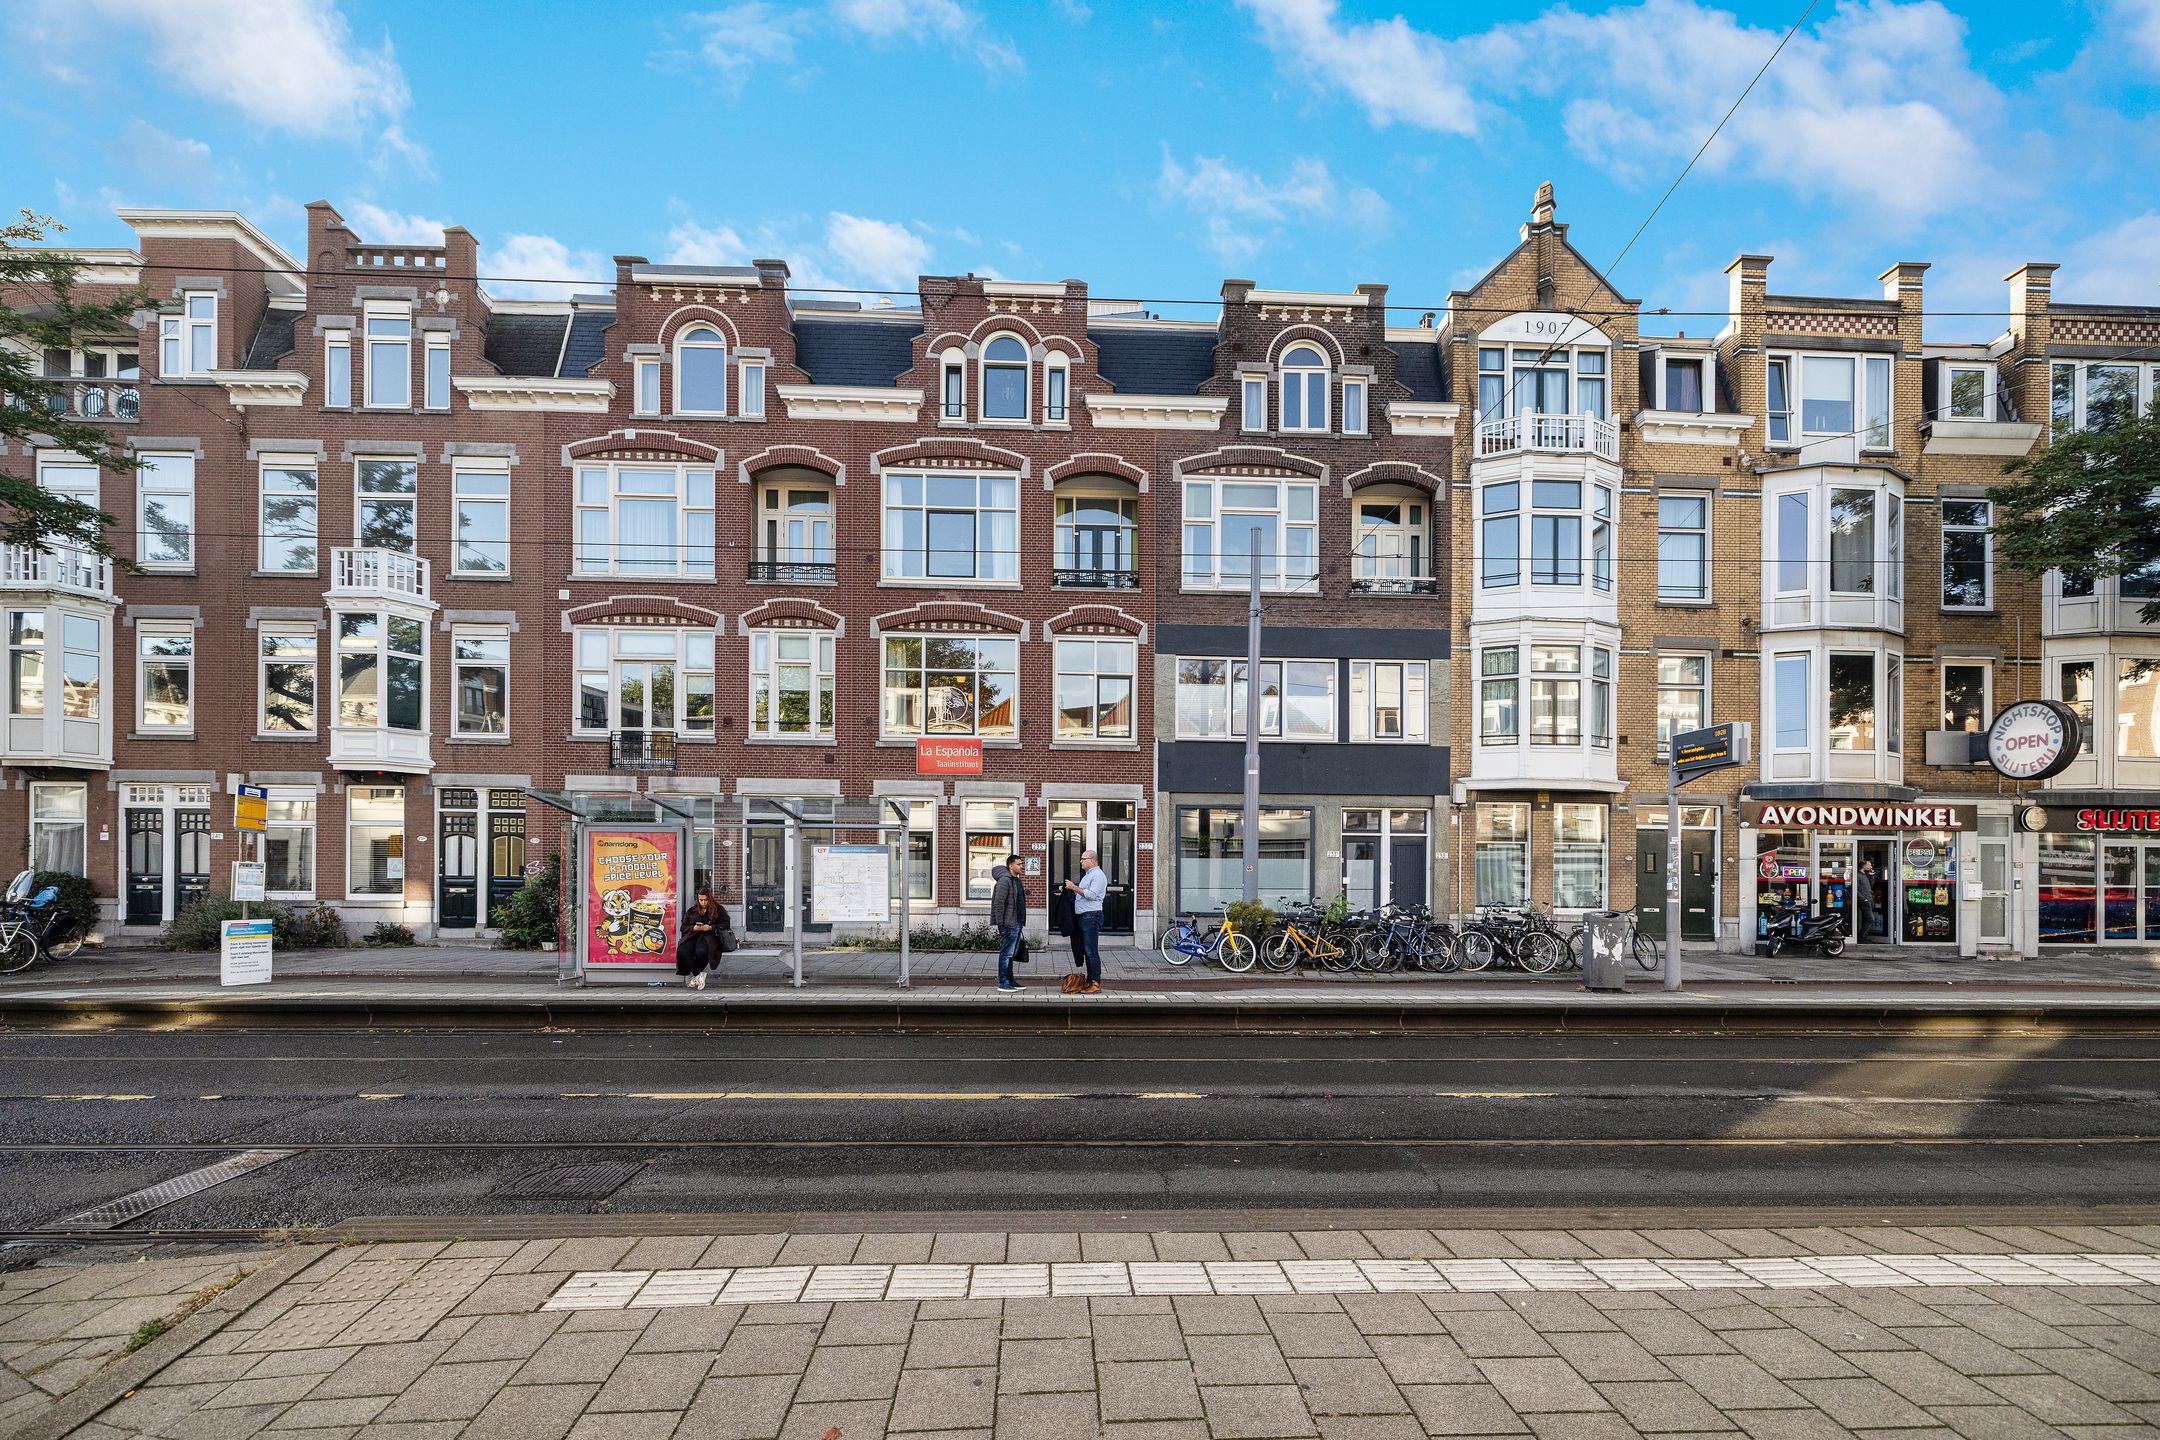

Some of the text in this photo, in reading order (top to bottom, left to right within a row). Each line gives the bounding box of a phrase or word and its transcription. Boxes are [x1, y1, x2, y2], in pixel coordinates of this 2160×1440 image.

[1525, 321, 1569, 335] 1907
[1994, 705, 2061, 741] NIGHTSHOP
[2005, 733, 2049, 751] OPEN
[920, 745, 979, 758] La Española
[936, 760, 978, 768] Taalinstituut
[1997, 748, 2057, 774] SLIJTERIJ
[1760, 805, 1962, 827] AVONDWINKEL
[2077, 809, 2160, 831] SLIJTE
[603, 840, 638, 849] namdong
[640, 852, 668, 862] YOUR
[1907, 848, 1933, 856] PEPSI
[1783, 868, 1806, 877] OPEN
